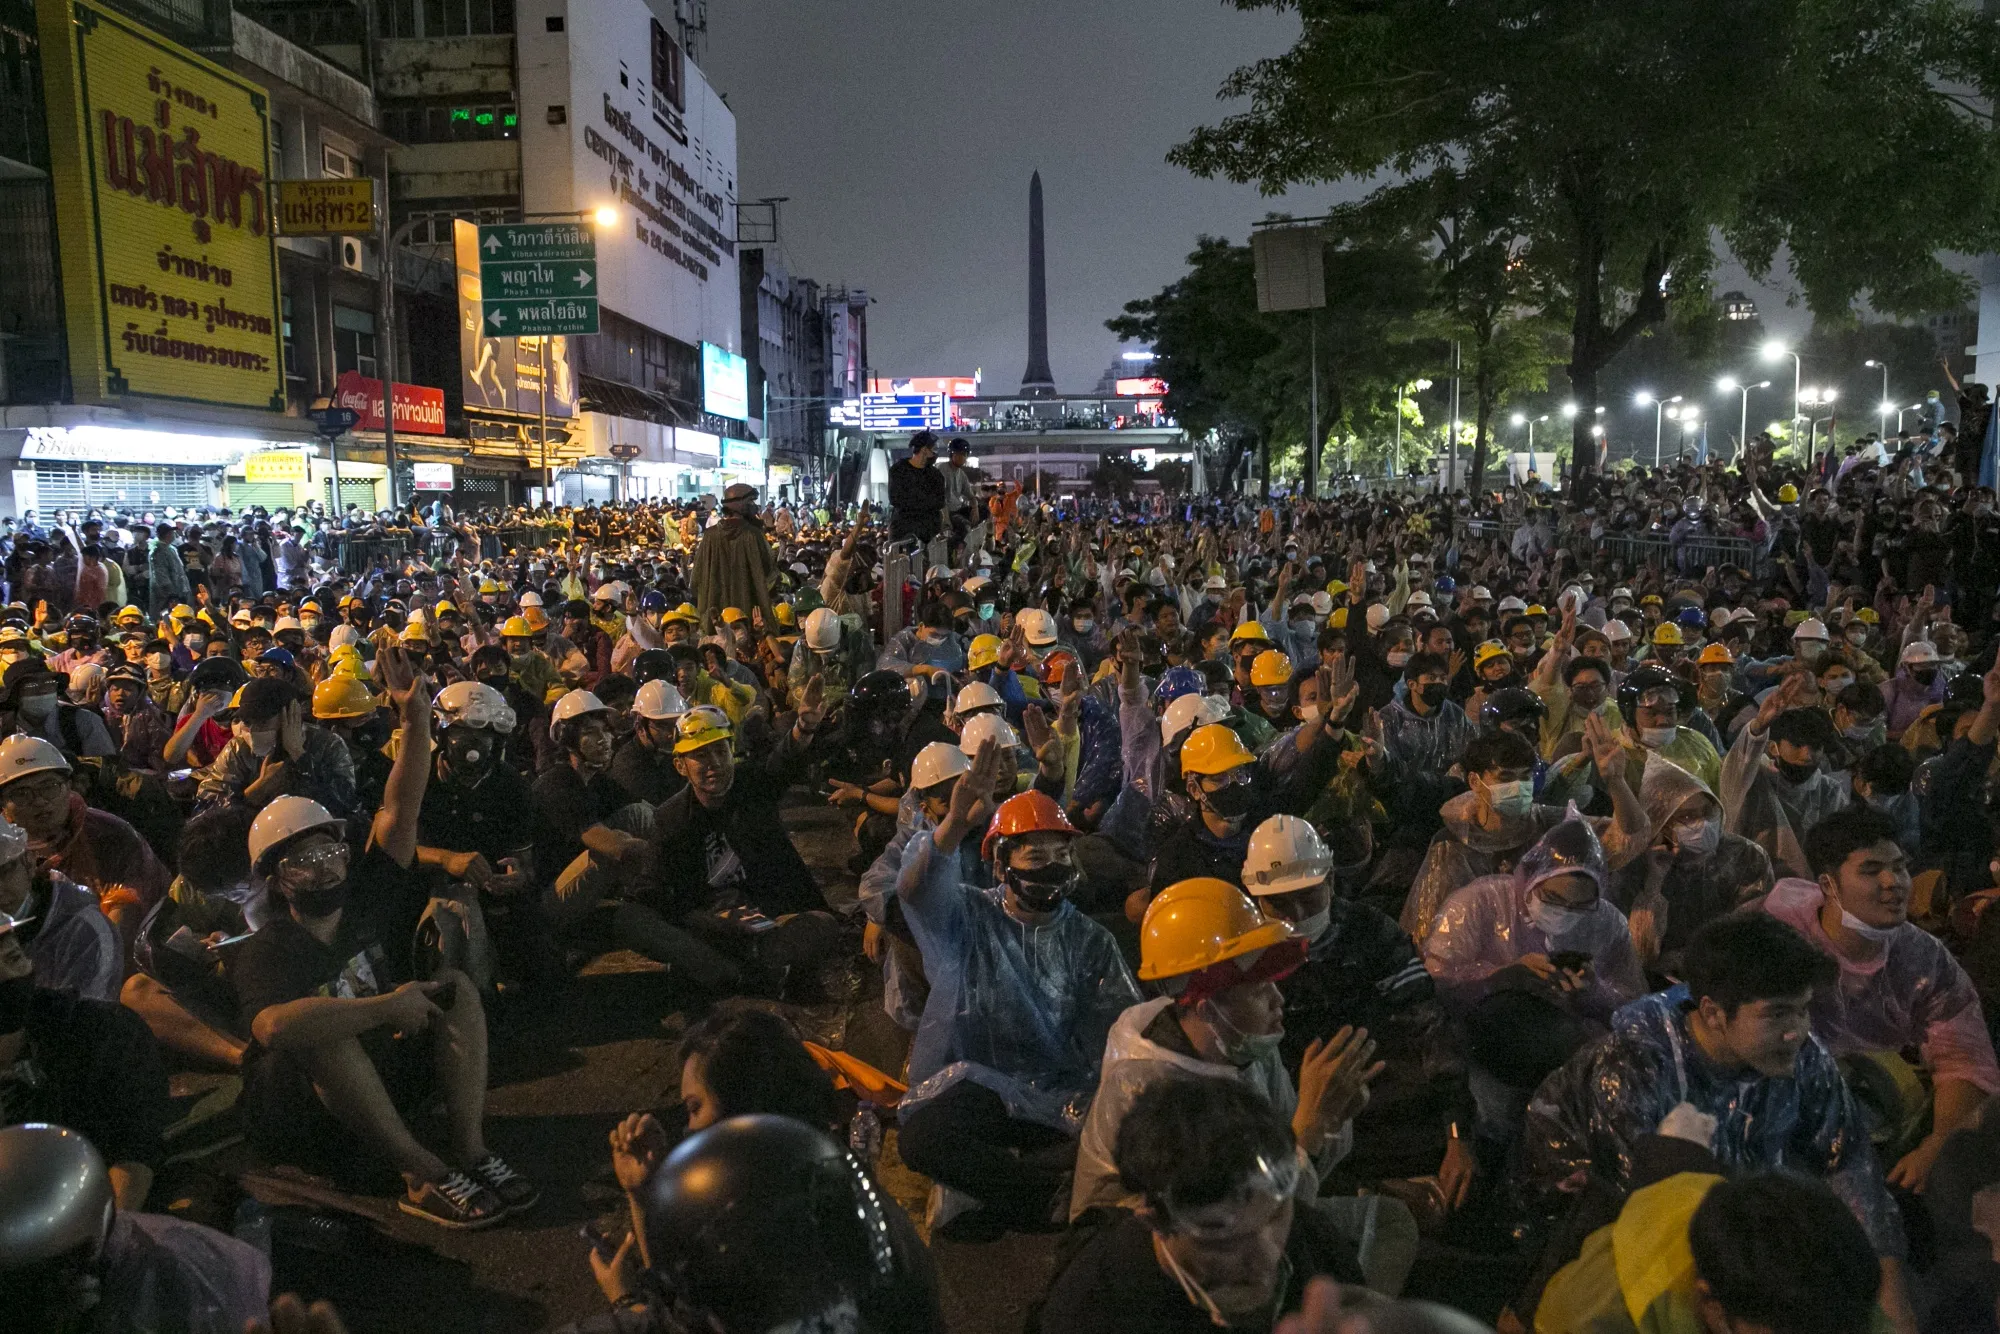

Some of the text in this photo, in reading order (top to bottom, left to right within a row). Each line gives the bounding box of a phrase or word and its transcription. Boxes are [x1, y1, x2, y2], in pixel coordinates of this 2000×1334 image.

[146, 66, 218, 120] ห้างทอง
[507, 226, 589, 246] วิภาวดีรังสิต
[156, 244, 232, 287] จำหน่าย
[500, 262, 554, 287] พญาไท
[504, 287, 552, 296] Phaya Thai
[161, 294, 199, 320] ทอง
[517, 299, 588, 321] พหลโยธิน
[558, 323, 585, 331] Yothin
[340, 412, 352, 421] 16
